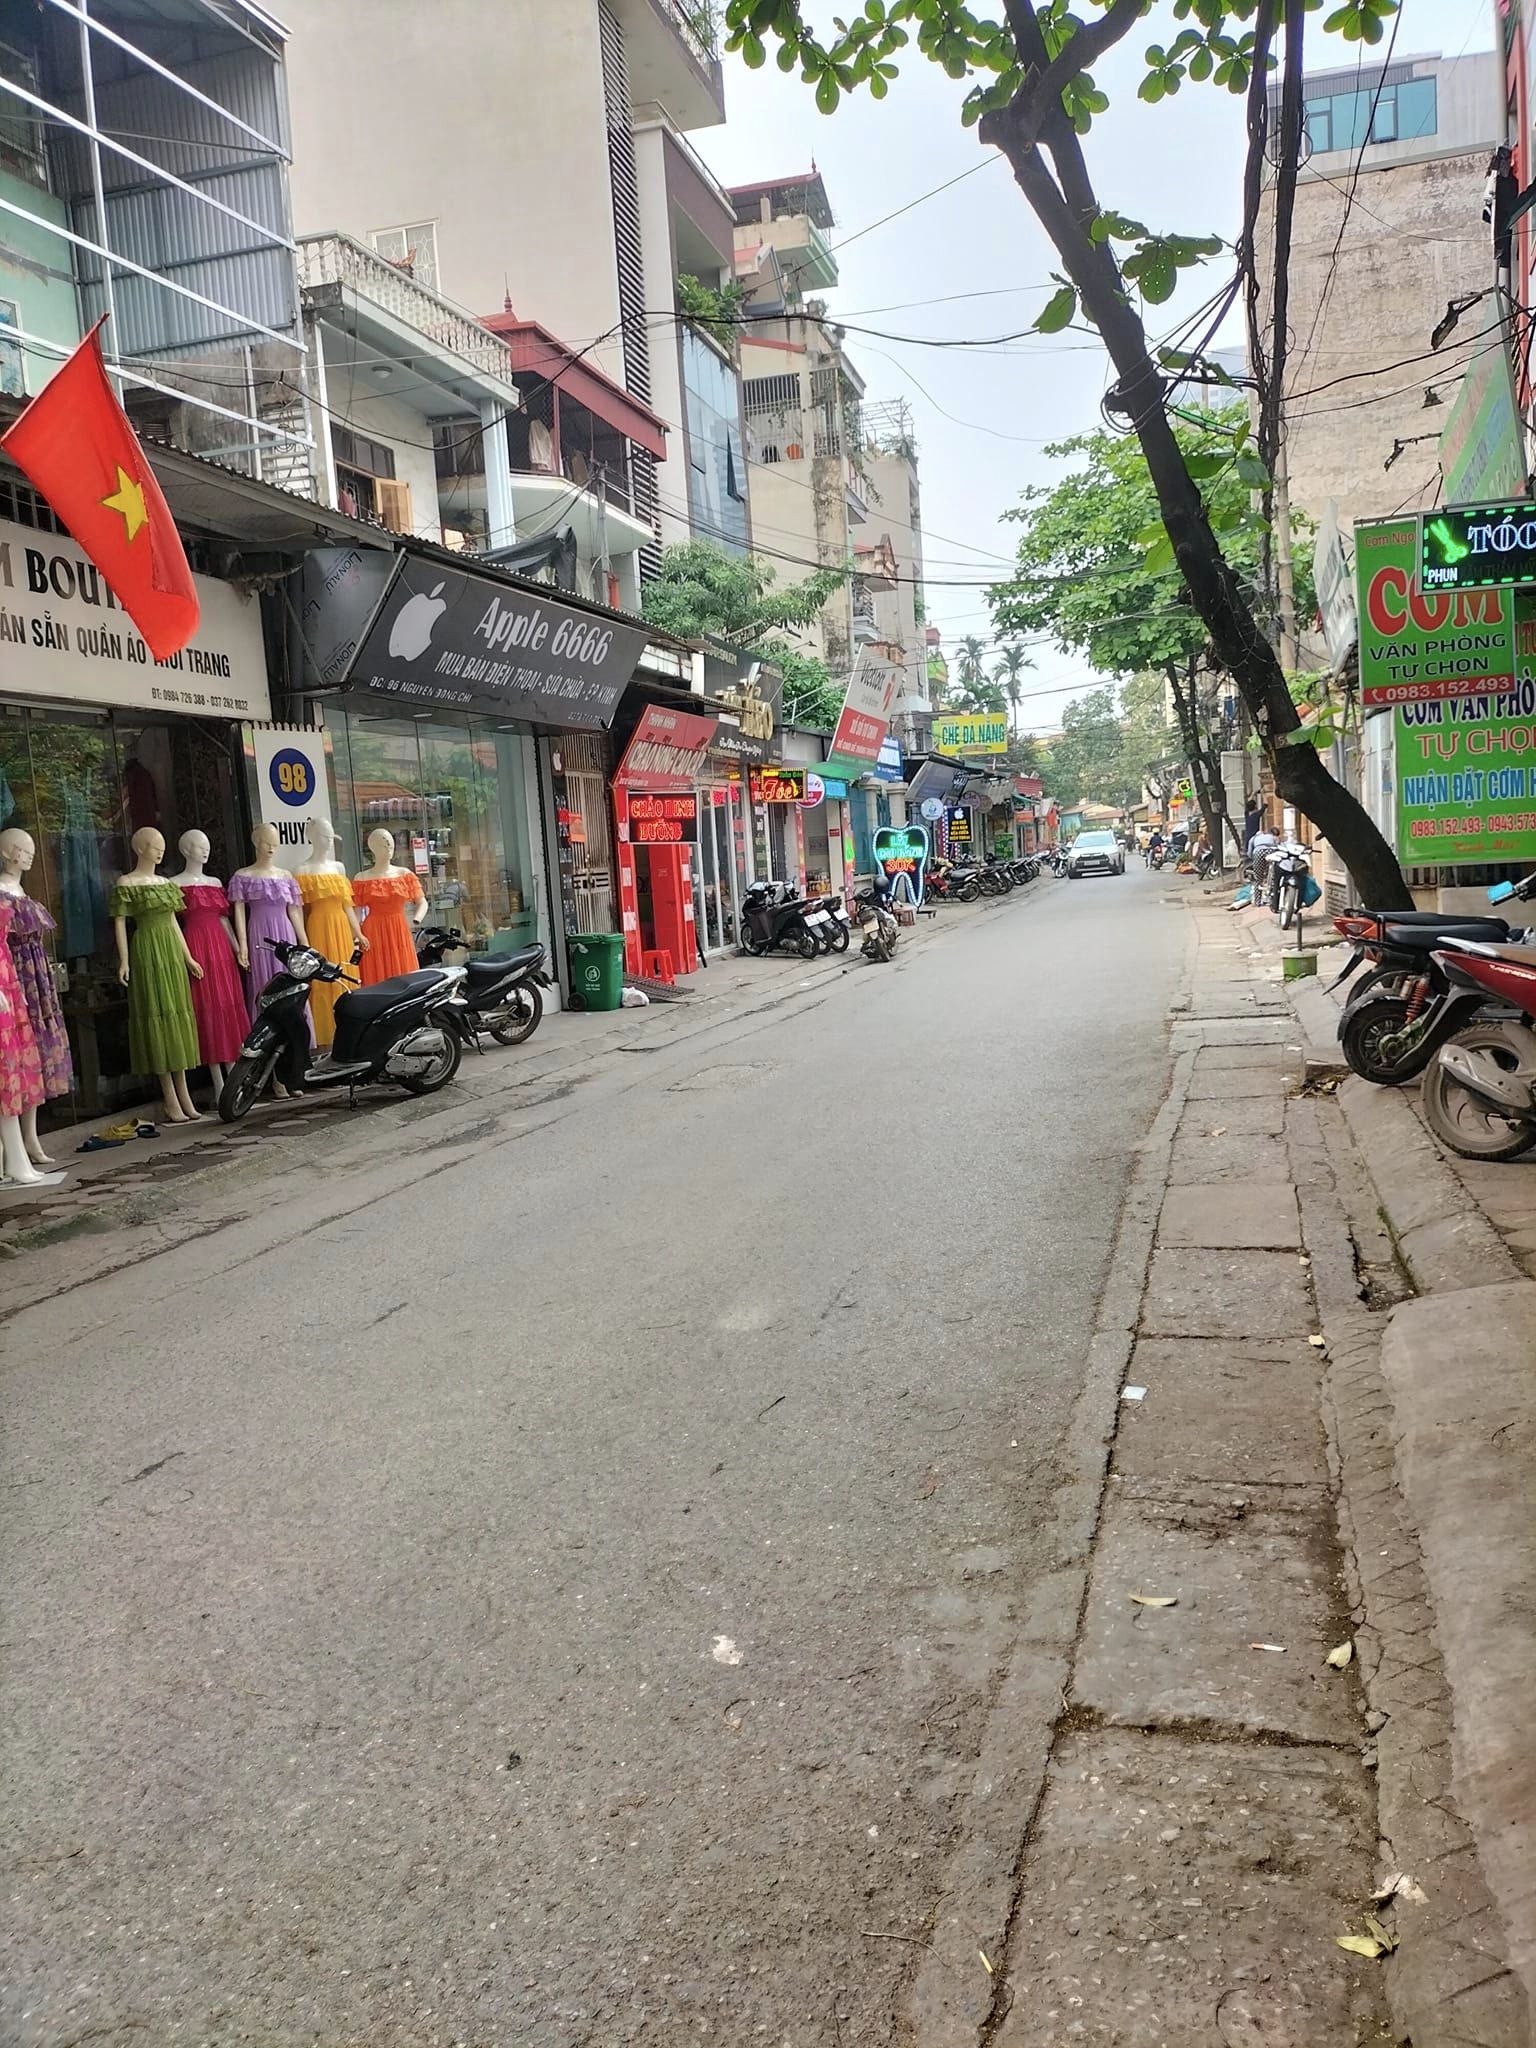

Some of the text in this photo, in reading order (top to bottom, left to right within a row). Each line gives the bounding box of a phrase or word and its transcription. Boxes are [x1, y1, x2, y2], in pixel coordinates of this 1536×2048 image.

[1467, 515, 1536, 553] TÓC
[1427, 567, 1458, 583] PHUN
[31, 610, 70, 651] SẴN
[76, 622, 122, 661] QUẦN
[127, 631, 147, 664] ÁO
[473, 597, 614, 665] Apple 6666
[186, 647, 231, 678] TRANG
[1370, 642, 1417, 661] VĂN
[1425, 633, 1506, 655] PHÒNG
[434, 651, 465, 675] MUA
[461, 654, 491, 682] BÁN
[484, 660, 514, 689] ĐIỆN
[1387, 657, 1489, 681] TỰ CHỌN
[387, 680, 400, 691] 96
[1385, 676, 1510, 701] 0983.152.493
[1496, 668, 1536, 718] PHÒ
[942, 721, 960, 746] CHÈ
[1415, 725, 1536, 760] TỰ CHỌ
[278, 762, 307, 793] 98
[1404, 769, 1449, 811] NHẬN
[1453, 767, 1483, 808] ĐẶT
[1489, 766, 1525, 799] CƠM
[269, 817, 313, 845] HUY
